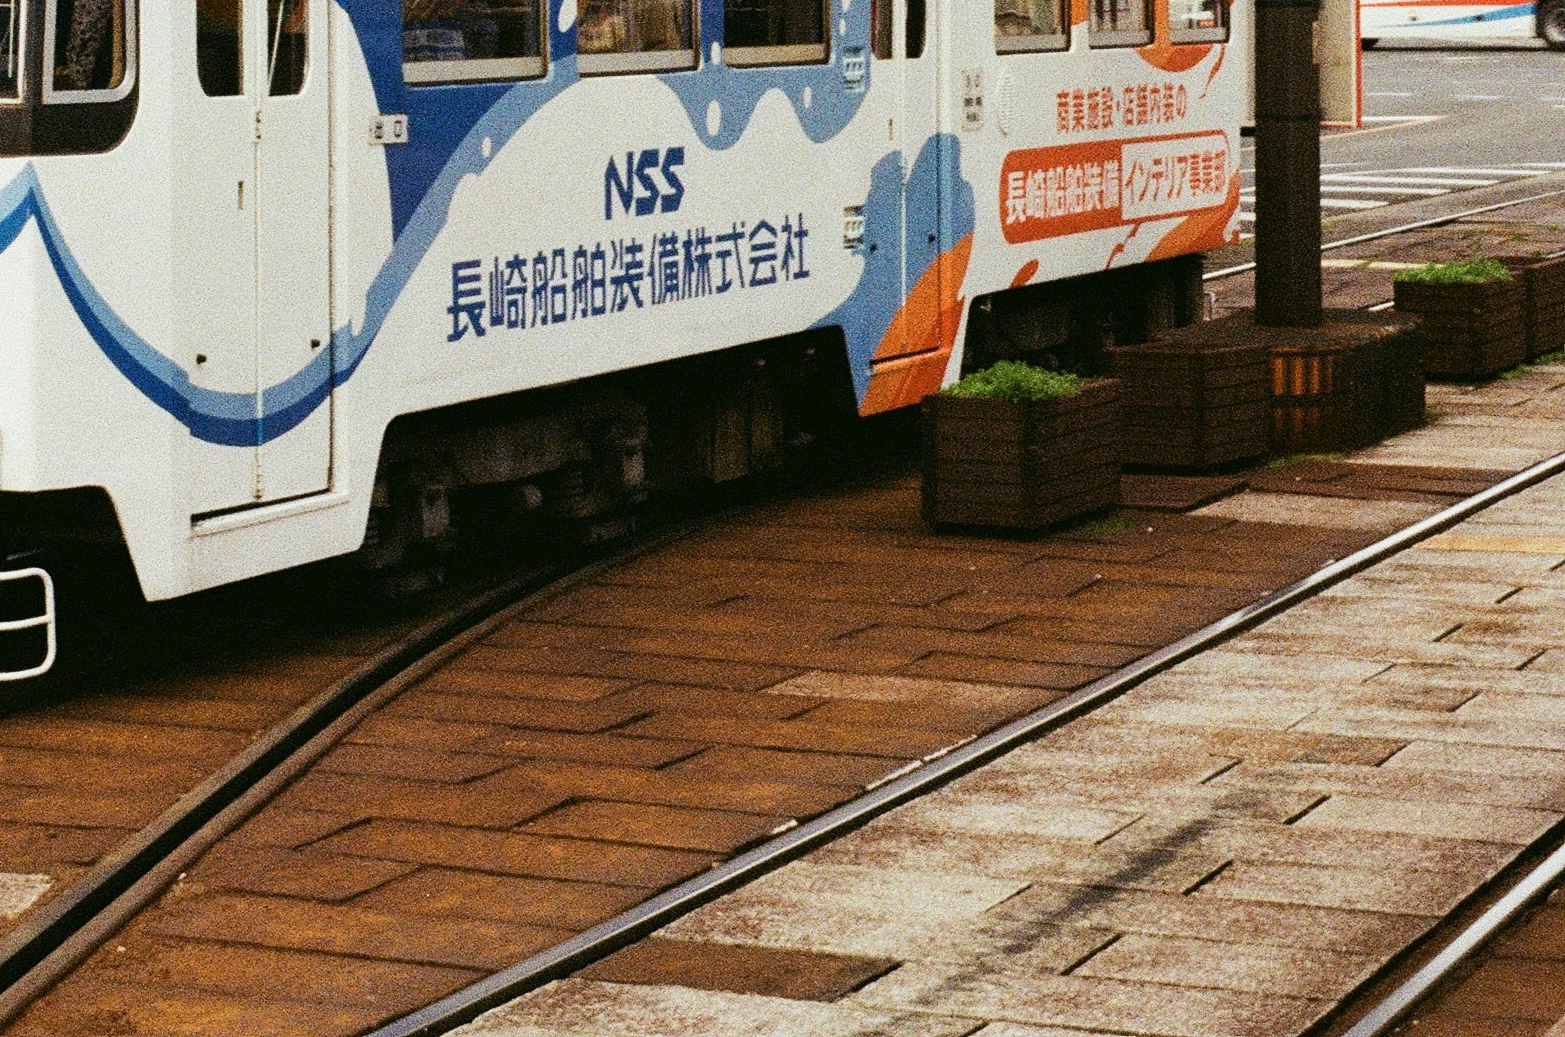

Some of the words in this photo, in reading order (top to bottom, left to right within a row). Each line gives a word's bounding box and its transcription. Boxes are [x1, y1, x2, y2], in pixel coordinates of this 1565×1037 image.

[604, 146, 686, 221] NSS
[1007, 159, 1120, 225] 長崎船舶装備
[446, 212, 810, 343] 長崎船舶装備株式会社
